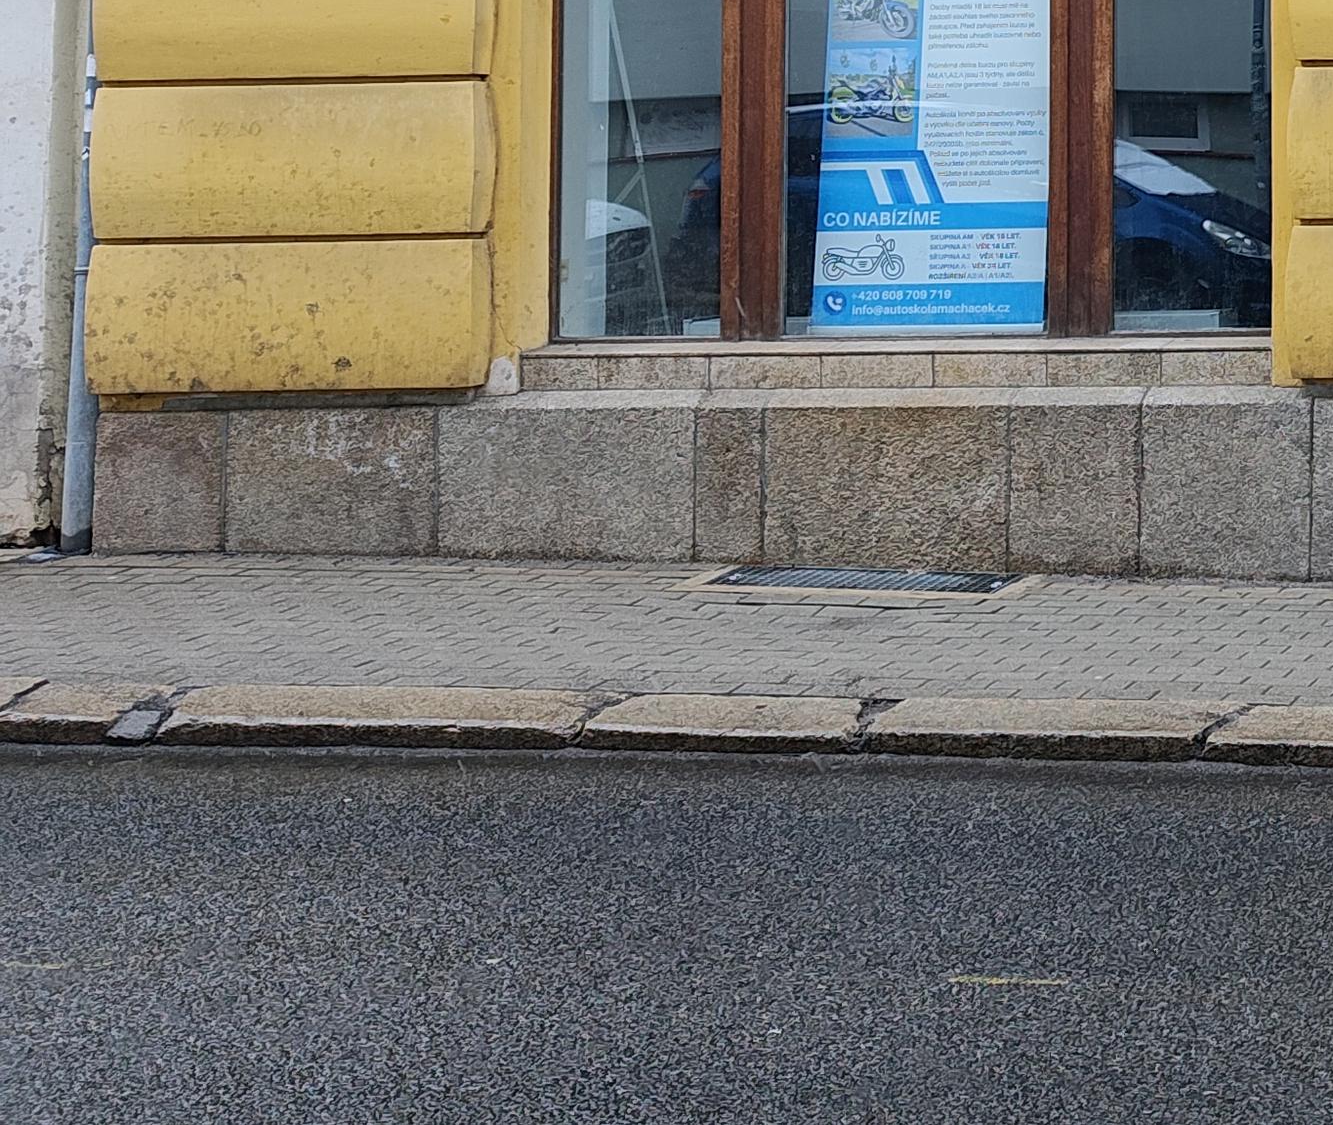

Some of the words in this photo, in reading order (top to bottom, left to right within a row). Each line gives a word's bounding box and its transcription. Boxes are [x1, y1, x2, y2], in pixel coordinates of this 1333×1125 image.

[823, 213, 849, 227] CO
[854, 209, 940, 226] NABÍZÍME
[906, 290, 928, 300] 709
